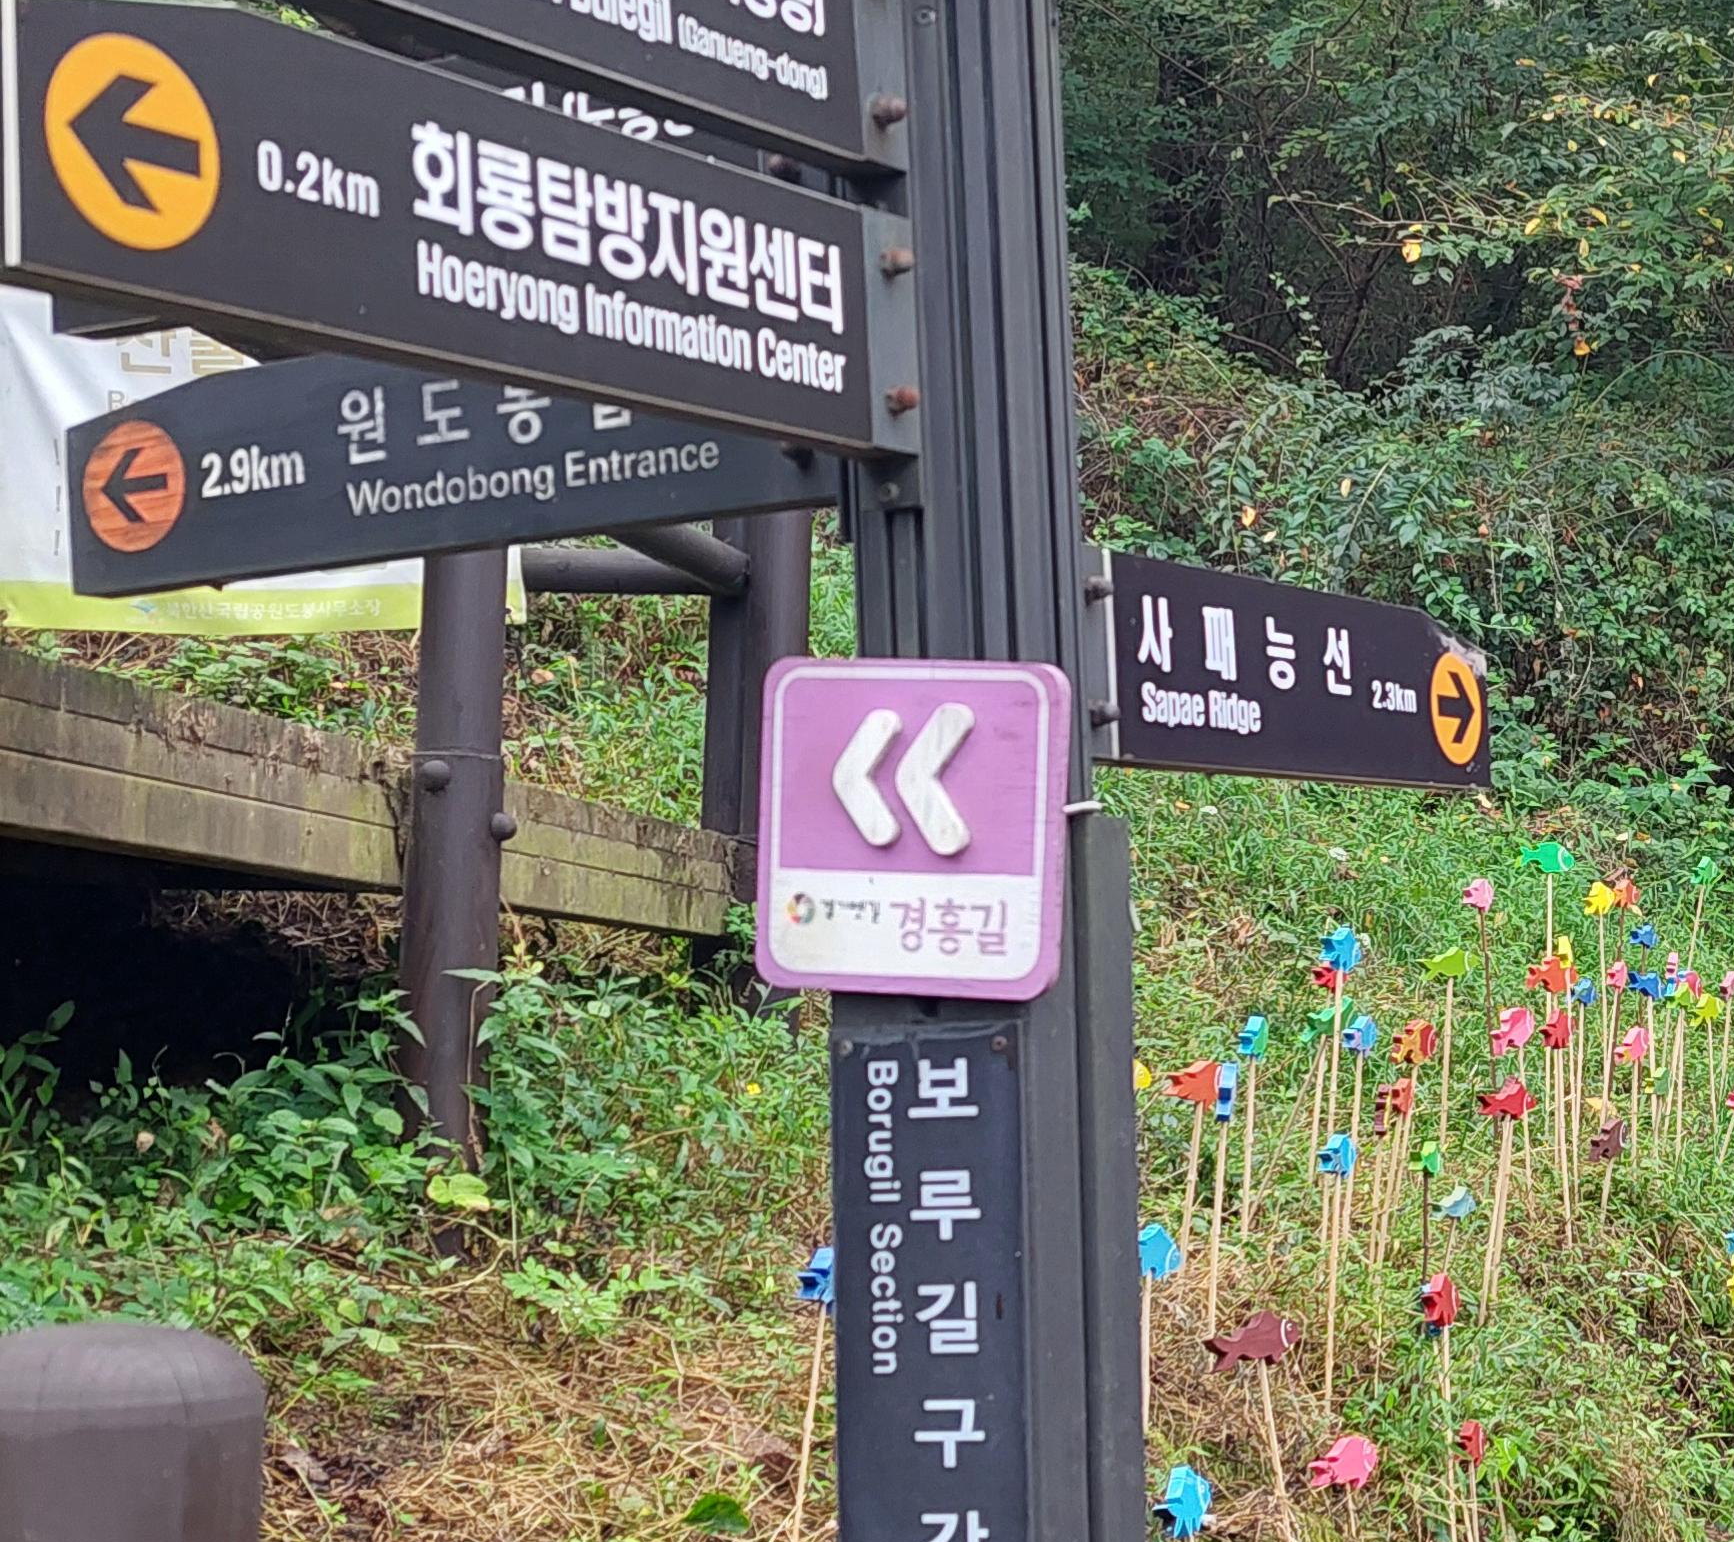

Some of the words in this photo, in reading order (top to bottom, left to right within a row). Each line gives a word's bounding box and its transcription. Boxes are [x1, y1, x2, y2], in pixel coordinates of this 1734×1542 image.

[257, 140, 380, 218] 0.2km
[411, 120, 844, 334] 회룡탐방지원센터
[417, 240, 579, 335] Hoeryong
[586, 282, 751, 371] Information
[757, 330, 846, 394] Center
[201, 445, 306, 498] 2.9km
[346, 465, 556, 517] Wondobong
[565, 441, 720, 488] Entrance
[1141, 682, 1205, 728] Sapae
[1208, 690, 1262, 735] Ridge
[1371, 679, 1417, 713] 2.3km
[889, 897, 1008, 955] 경흥길
[864, 1060, 902, 1205] Borugil
[870, 1222, 905, 1375] Section
